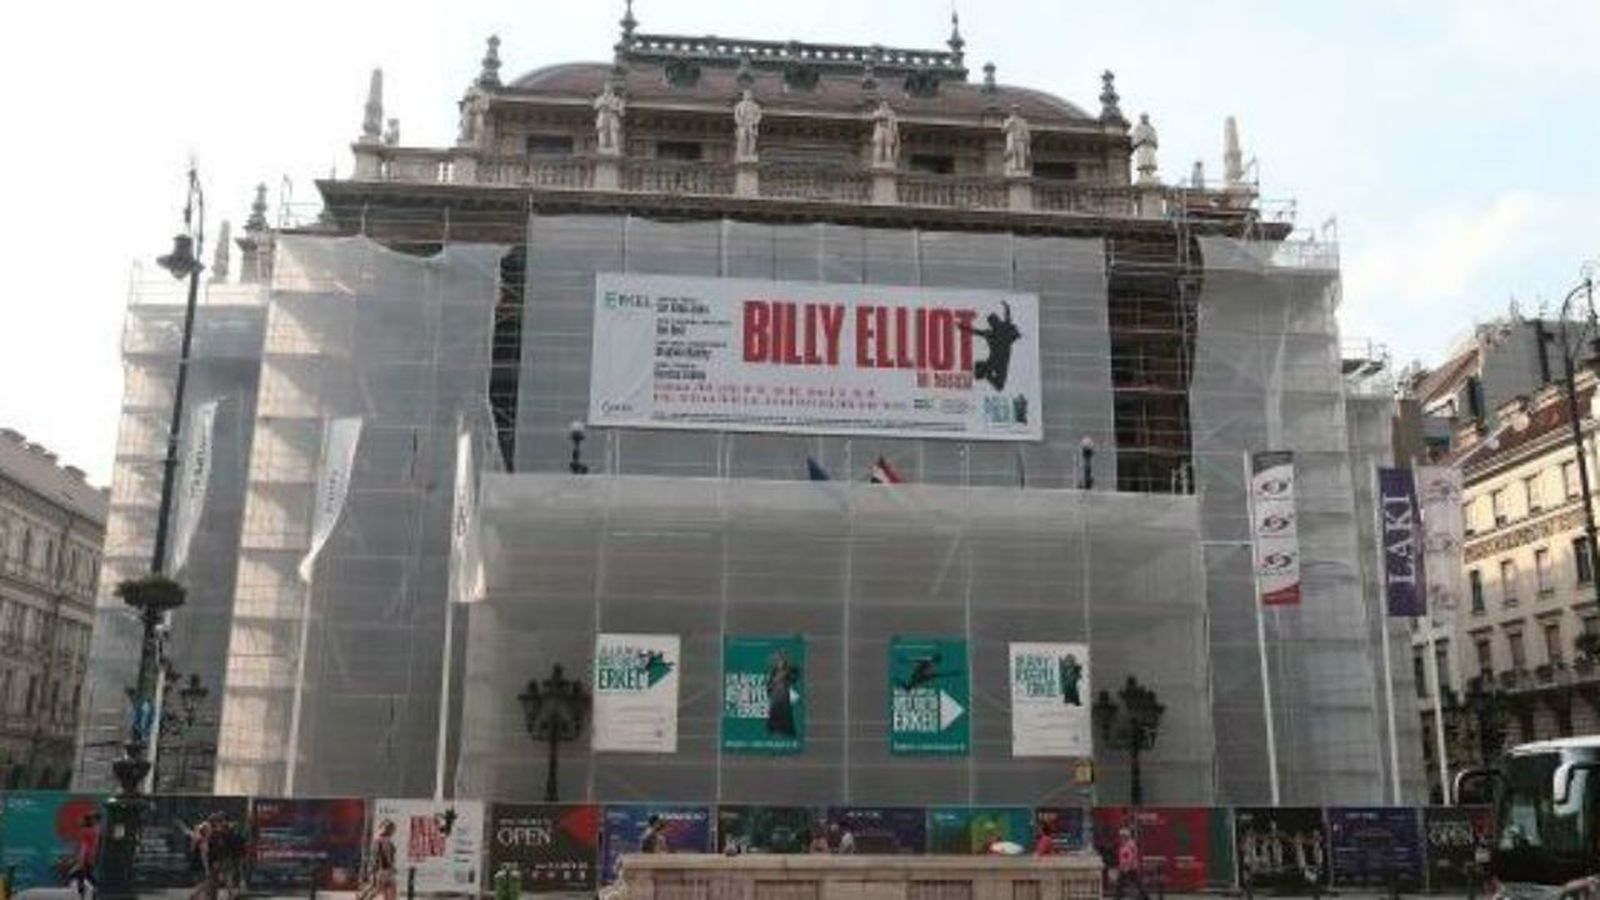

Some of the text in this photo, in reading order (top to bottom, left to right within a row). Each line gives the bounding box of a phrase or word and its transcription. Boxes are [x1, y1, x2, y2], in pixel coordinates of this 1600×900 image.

[743, 300, 976, 371] BILLY ELLIOT
[1383, 494, 1415, 584] LAKI
[497, 827, 551, 846] OPEN
